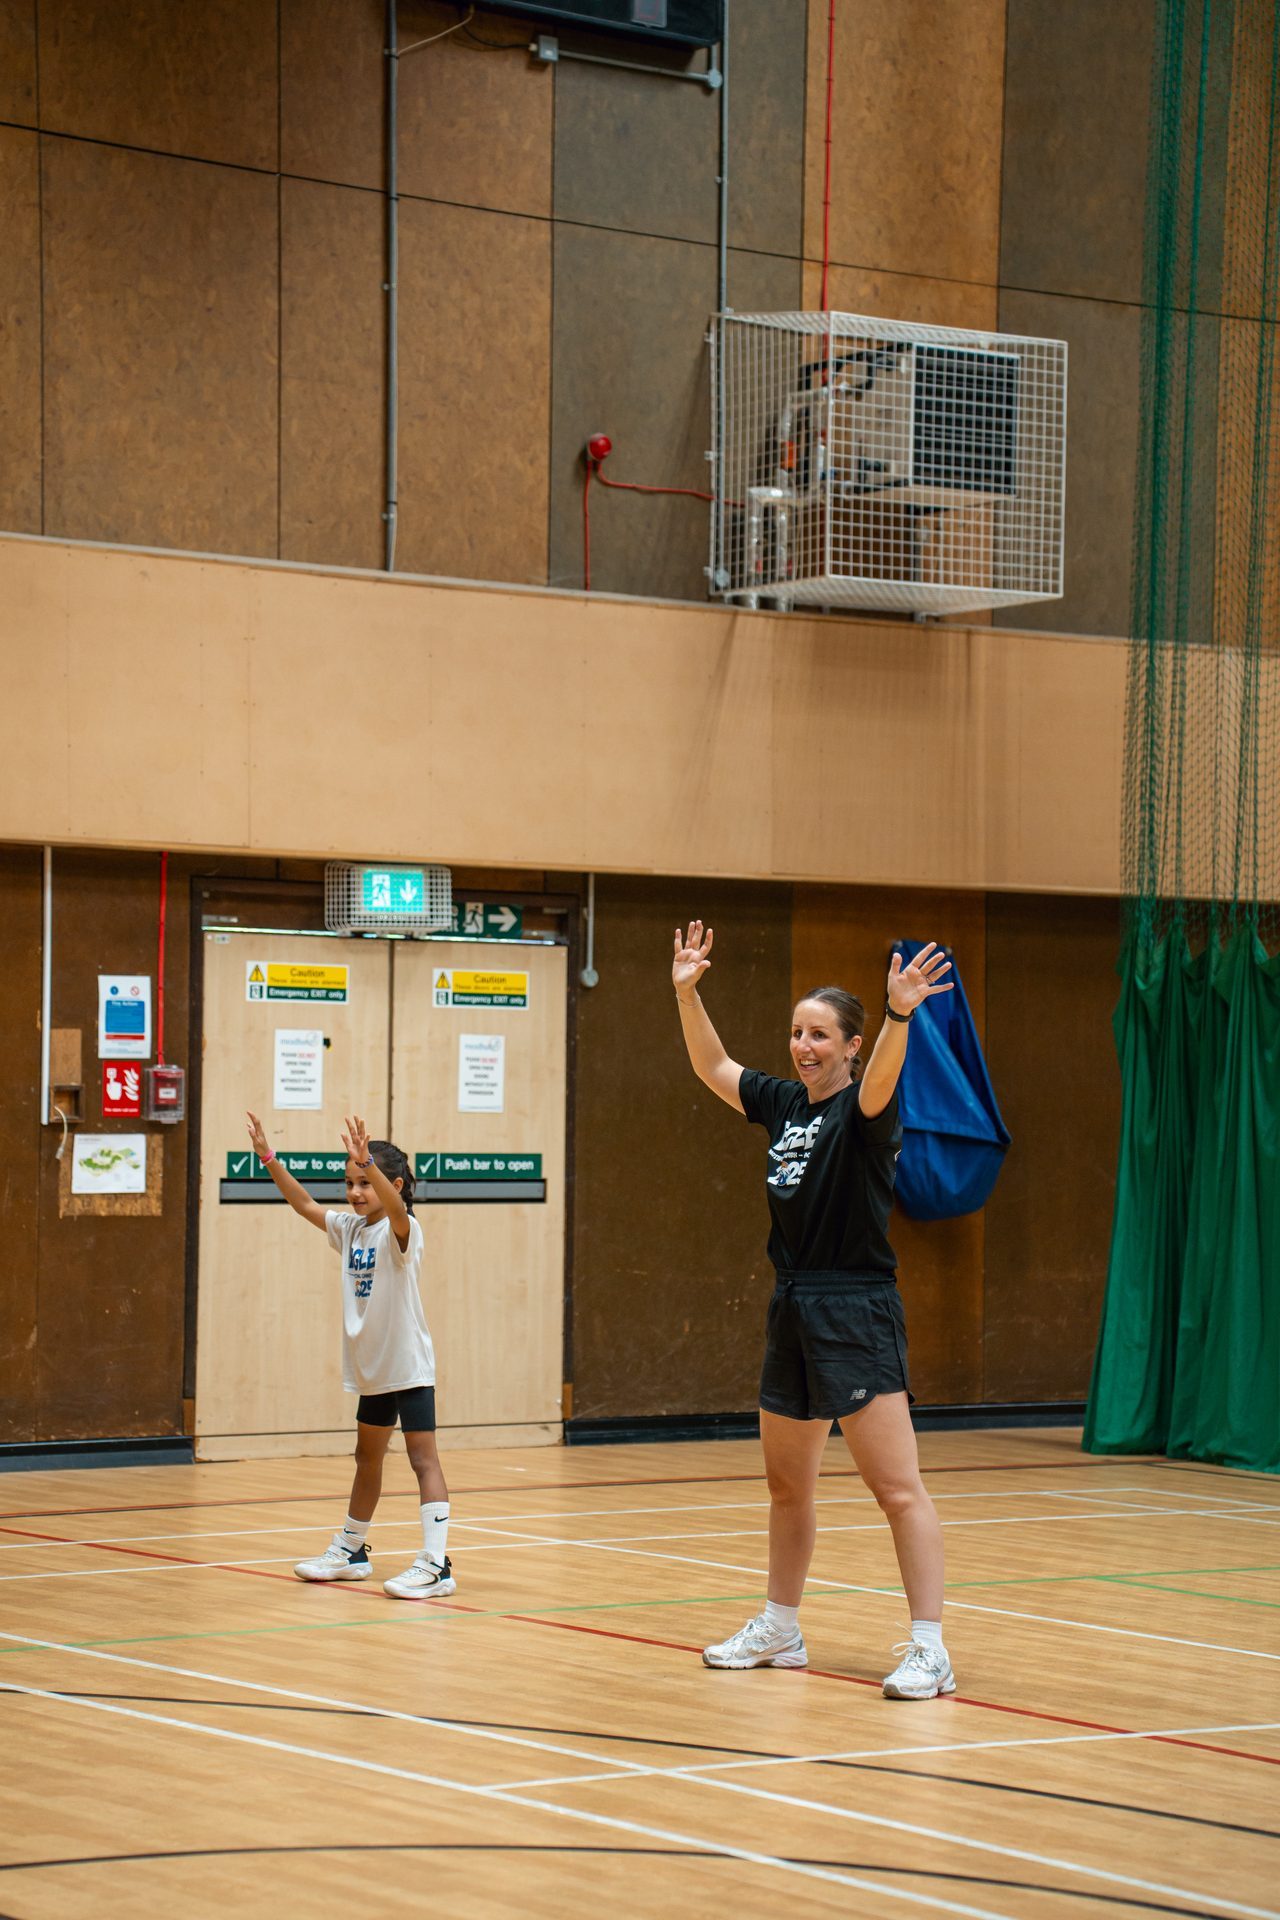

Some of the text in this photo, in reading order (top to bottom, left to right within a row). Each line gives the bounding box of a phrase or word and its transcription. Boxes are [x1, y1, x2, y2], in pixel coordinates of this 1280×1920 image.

[290, 968, 325, 977] Caution
[473, 975, 507, 984] Caution
[269, 988, 344, 1000] Emergency EXIT only
[454, 994, 525, 1005] Emergency EXIT only
[289, 1159, 308, 1170] bar
[311, 1159, 323, 1170] to
[326, 1161, 346, 1172] ope
[445, 1158, 534, 1172] Push bar to open
[850, 1389, 867, 1400] NB
